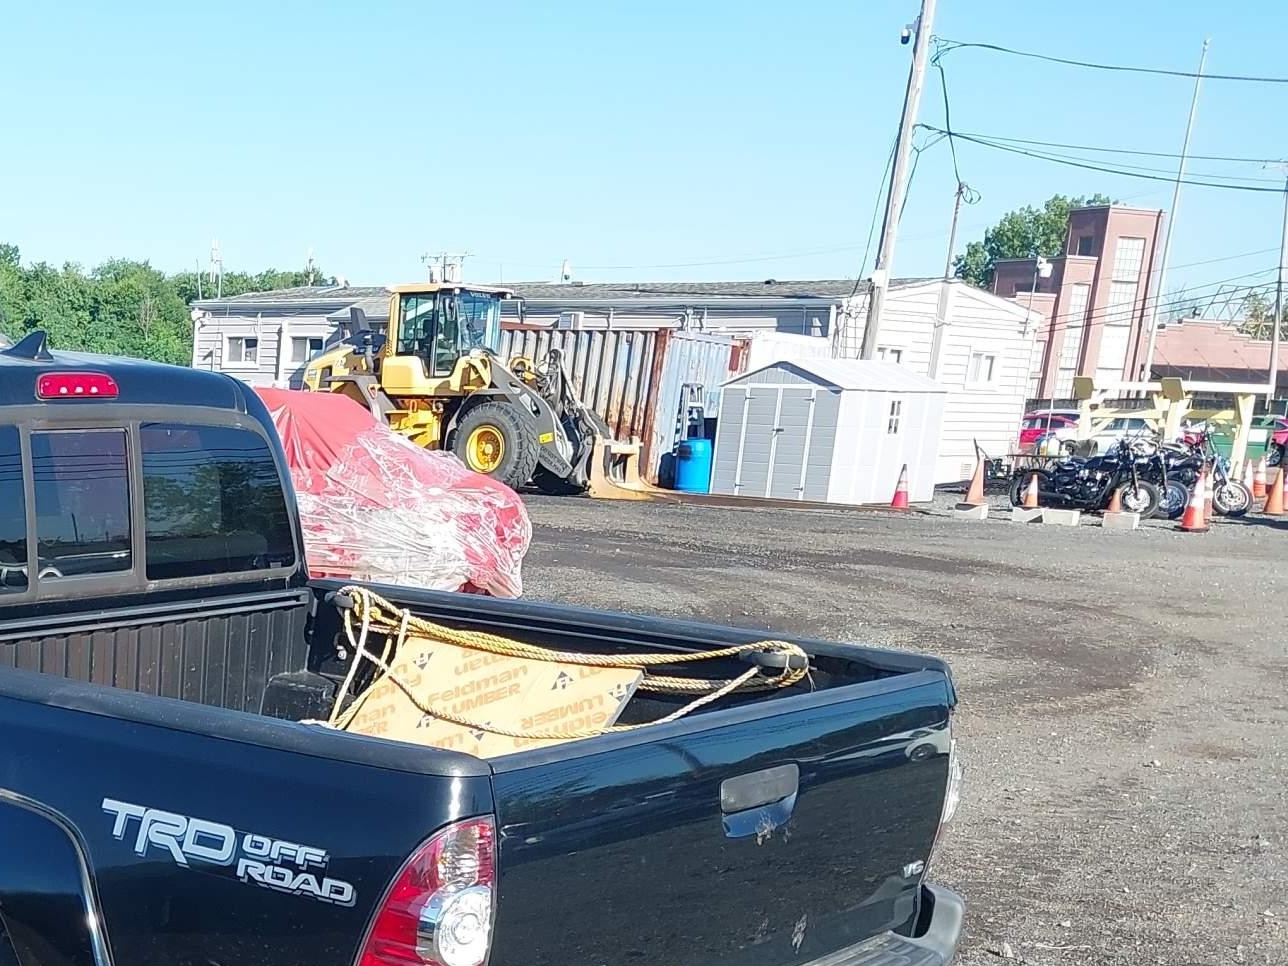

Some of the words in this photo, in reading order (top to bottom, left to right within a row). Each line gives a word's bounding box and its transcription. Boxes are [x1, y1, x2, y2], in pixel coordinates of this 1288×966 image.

[427, 664, 528, 704] Feldman
[451, 682, 521, 714] UMBER
[101, 797, 238, 869] TRD
[242, 833, 329, 870] OFF
[236, 857, 358, 908] ROAD
[903, 859, 924, 879] V6
